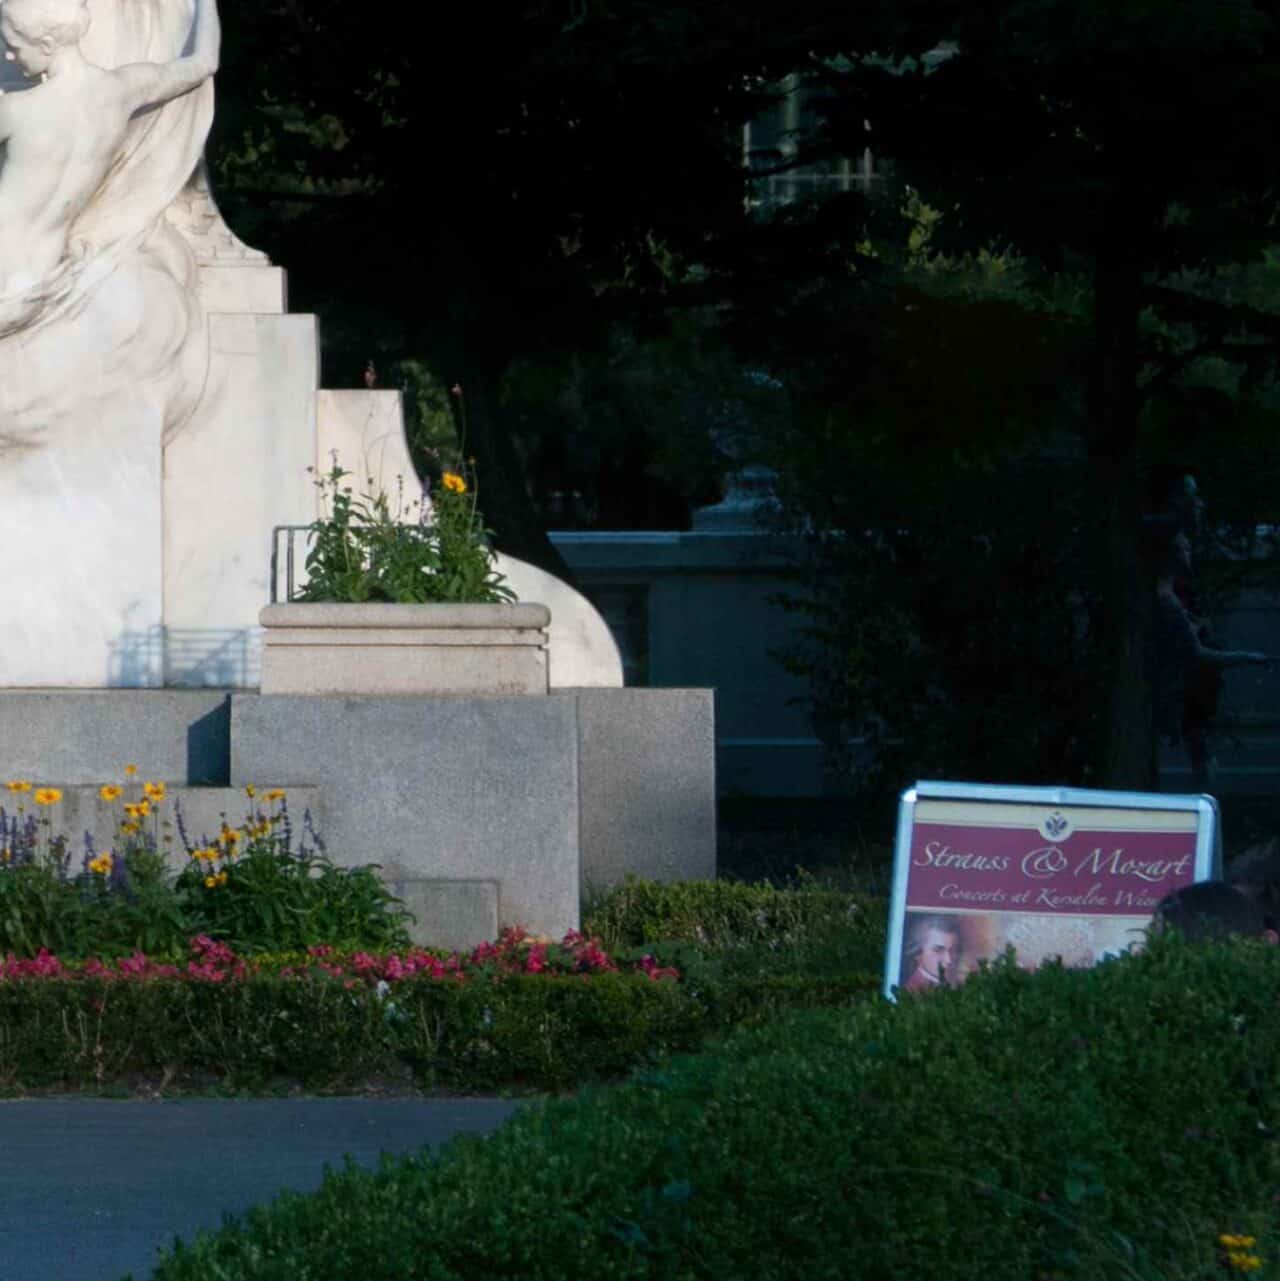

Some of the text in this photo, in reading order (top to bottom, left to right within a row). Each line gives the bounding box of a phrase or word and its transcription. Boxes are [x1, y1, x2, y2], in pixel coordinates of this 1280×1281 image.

[914, 841, 1193, 882] Strauss & Mozart
[939, 883, 1006, 904] Concerts
[1011, 889, 1032, 904] at
[1035, 882, 1107, 909] Kursalon
